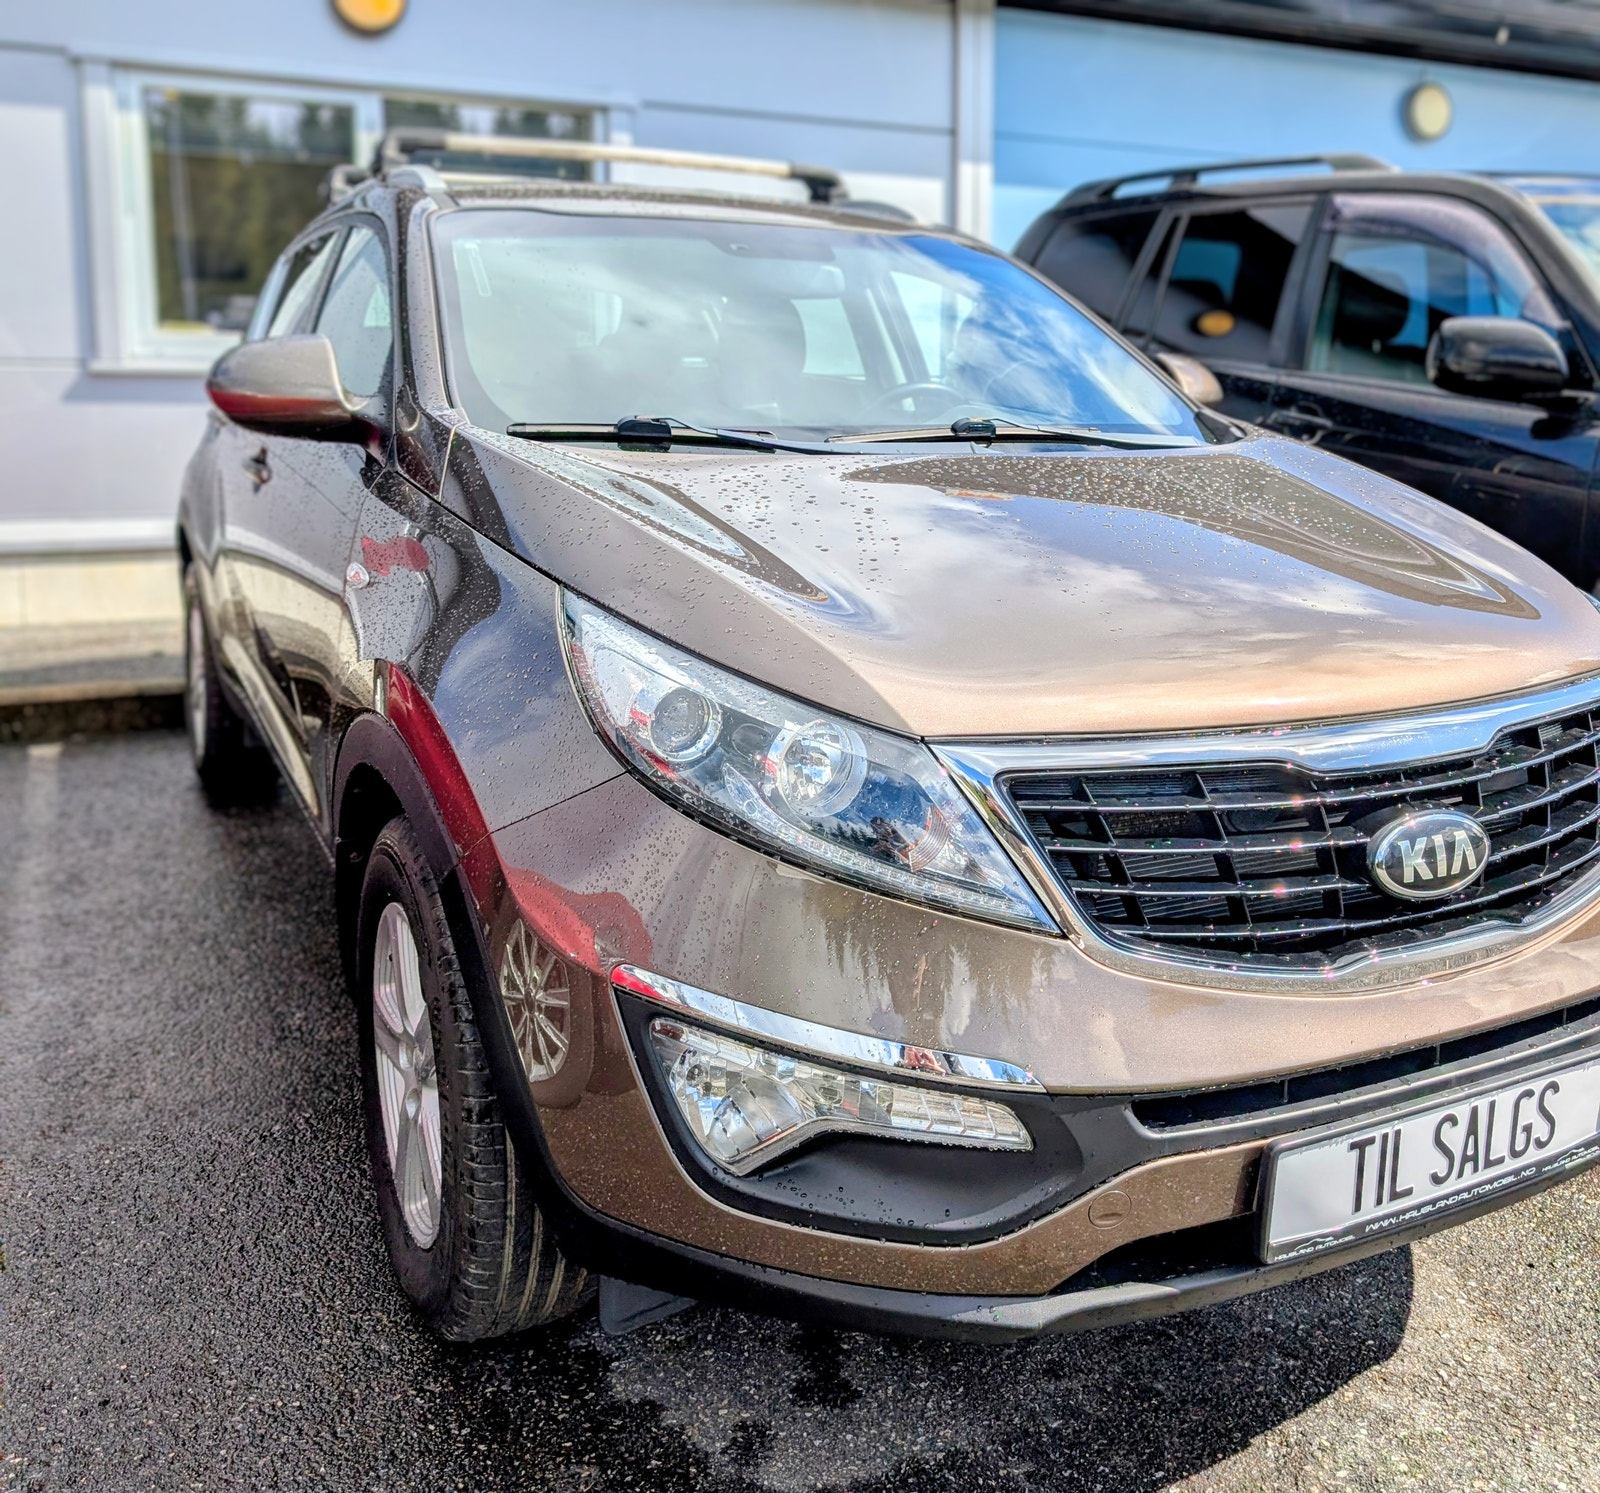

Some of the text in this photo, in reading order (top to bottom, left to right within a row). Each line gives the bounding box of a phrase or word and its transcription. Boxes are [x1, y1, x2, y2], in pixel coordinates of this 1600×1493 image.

[1398, 830, 1477, 883] KIA
[1349, 1080, 1560, 1215] TIL SALGS
